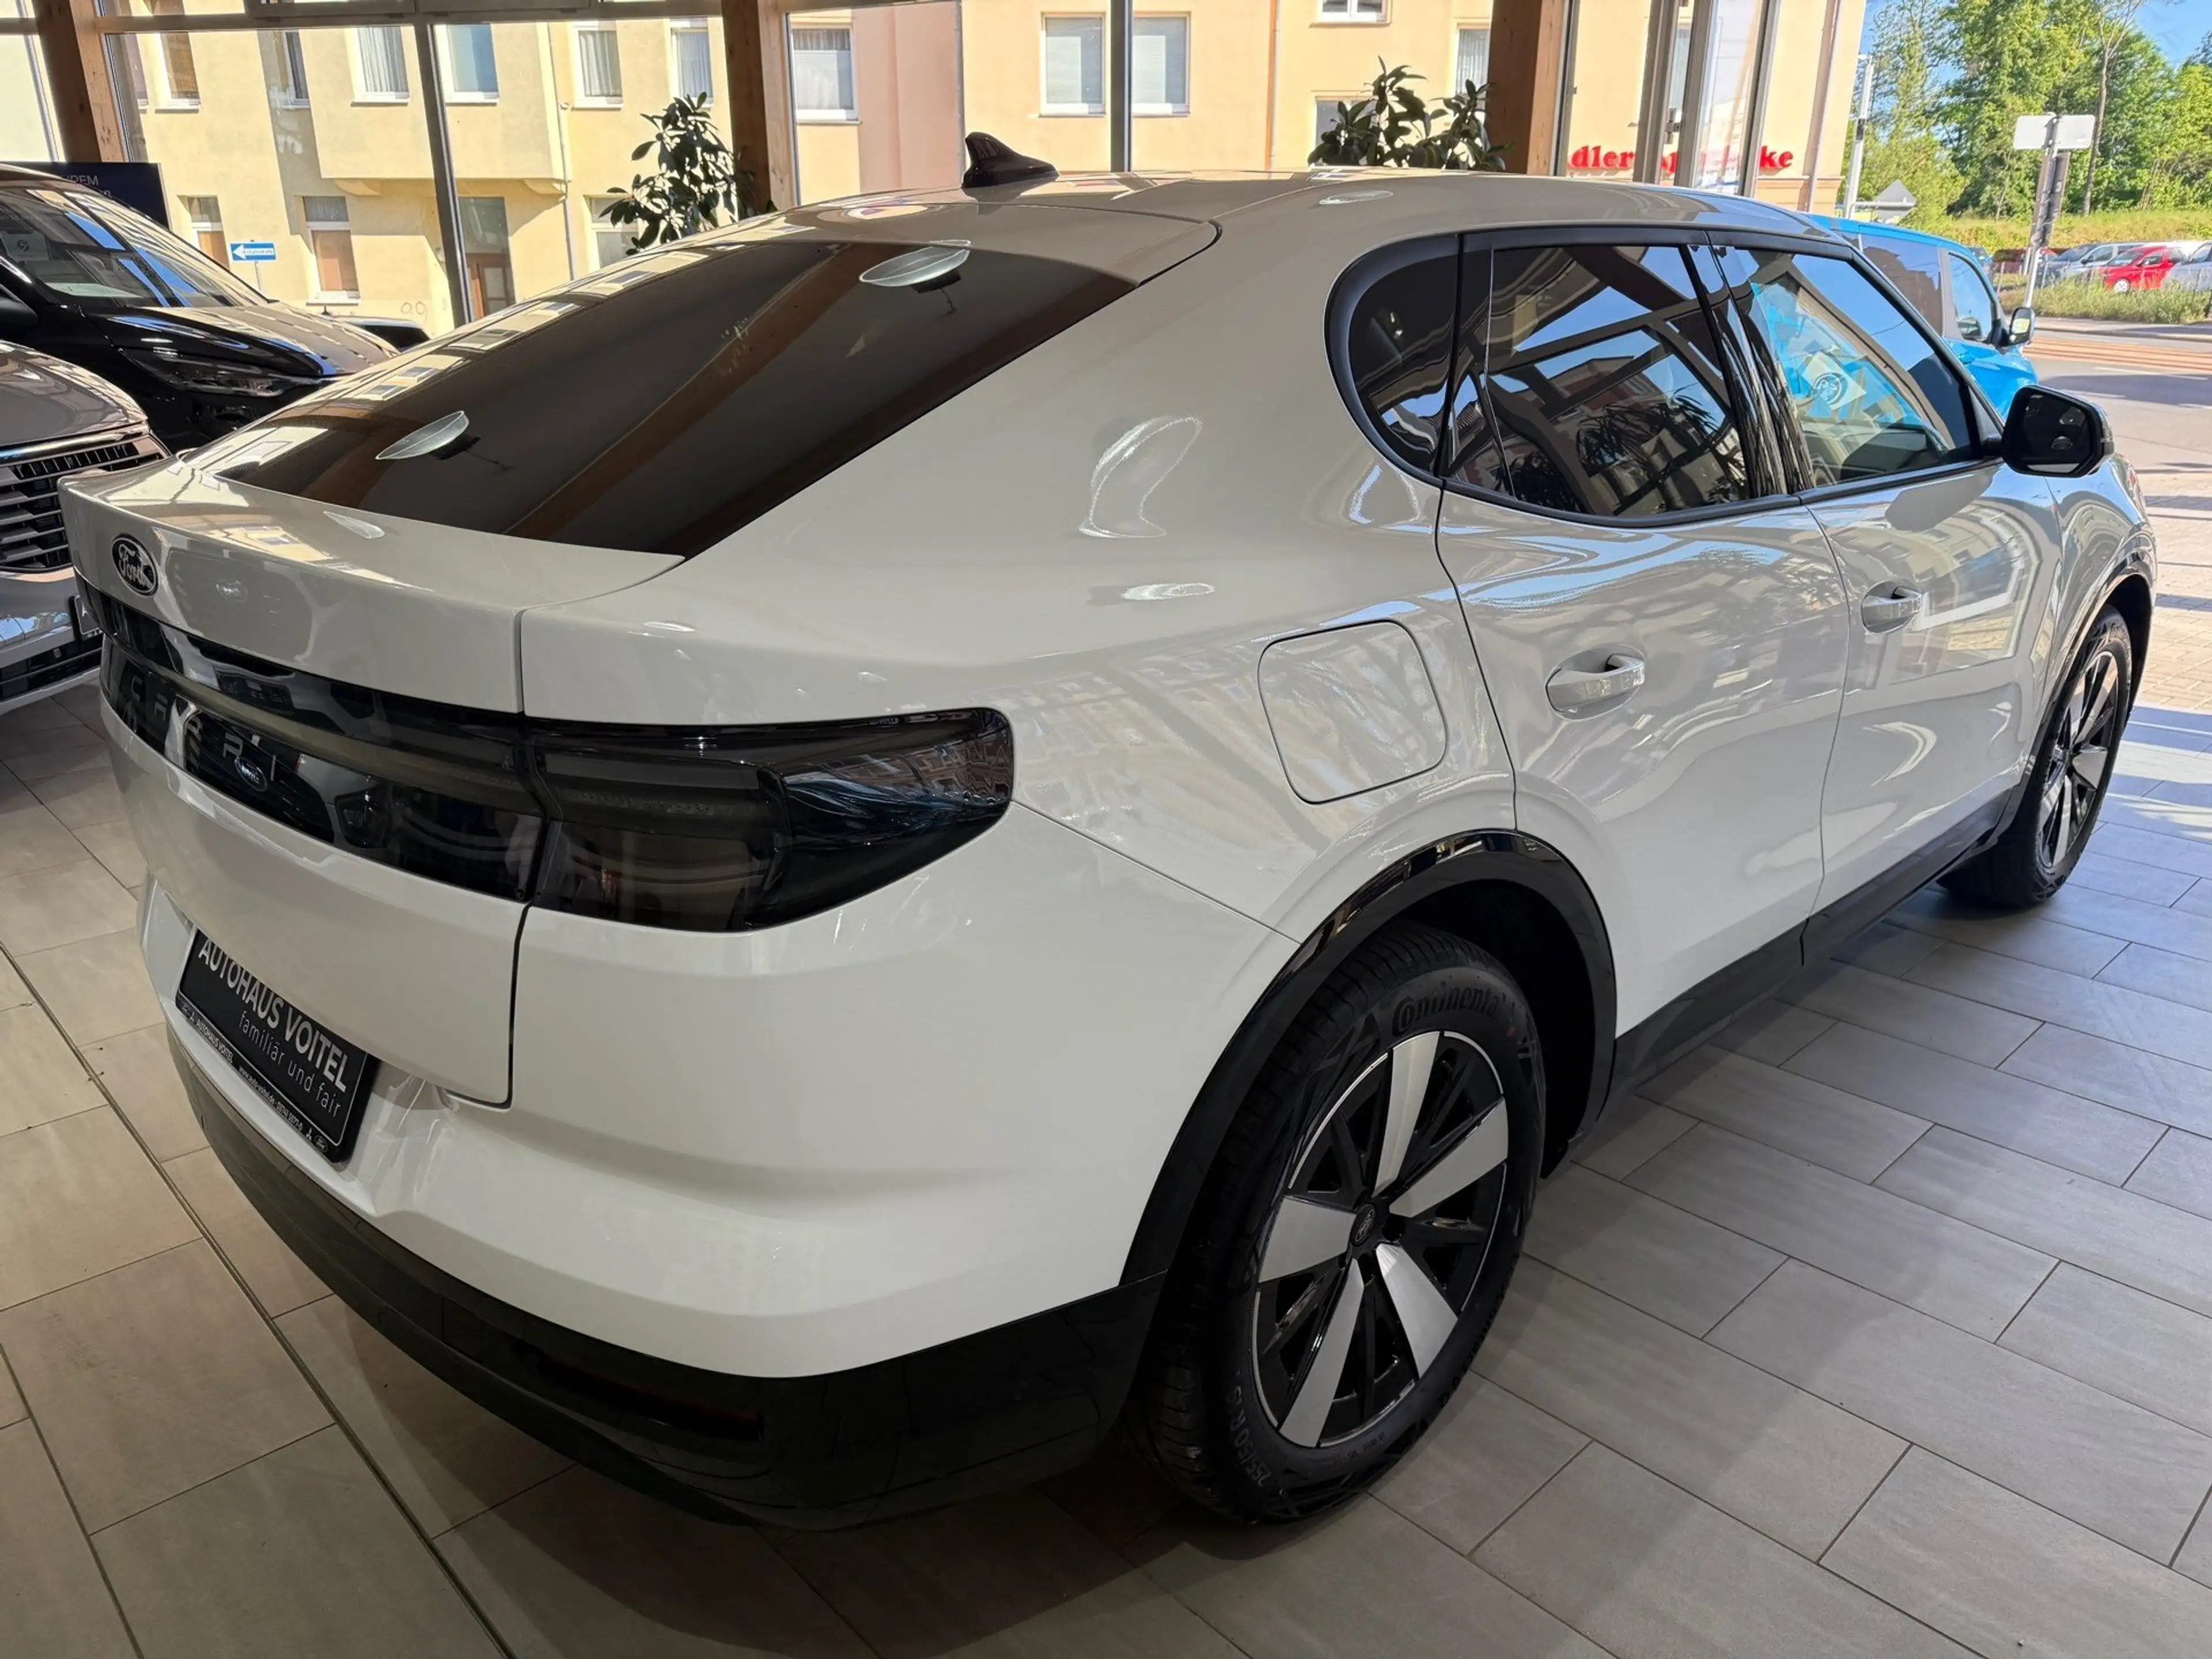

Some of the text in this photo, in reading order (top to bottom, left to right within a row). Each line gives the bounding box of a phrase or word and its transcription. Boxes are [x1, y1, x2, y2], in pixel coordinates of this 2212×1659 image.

[1568, 145, 1636, 169] dler
[117, 542, 153, 590] Ford
[198, 938, 348, 1093] AUTOHAUS VOITEL
[238, 1010, 341, 1118] familiär und fair
